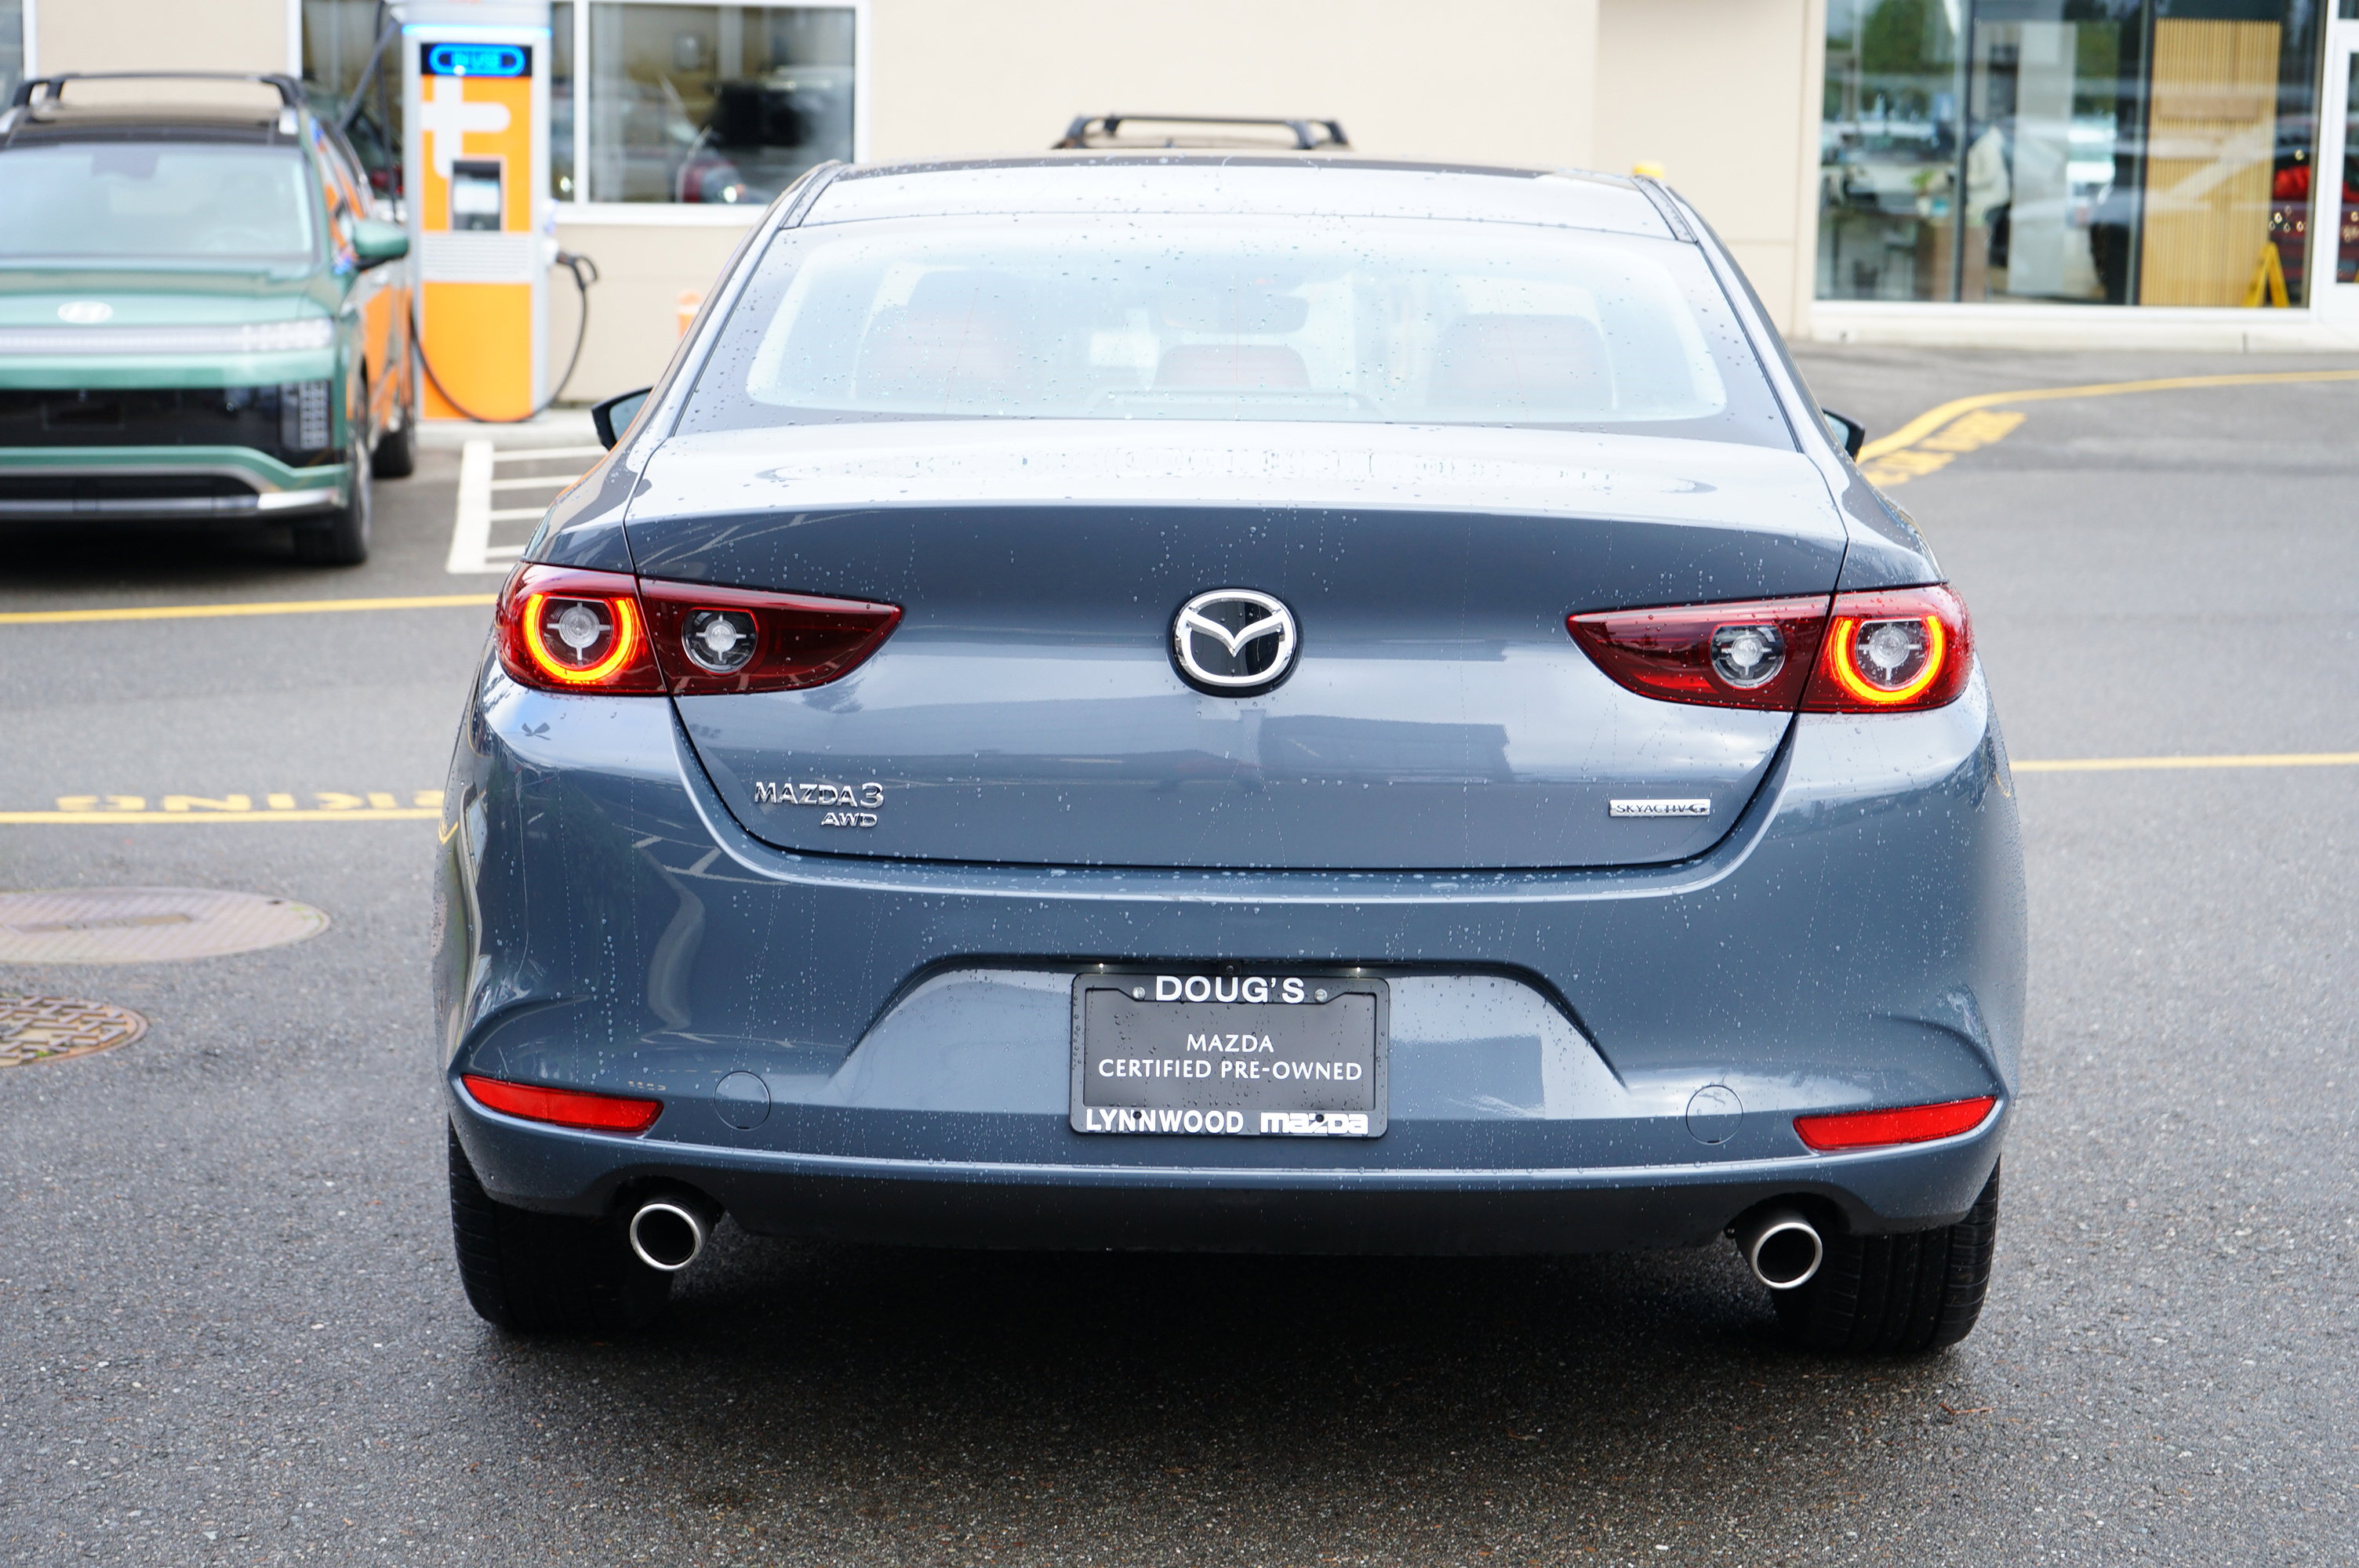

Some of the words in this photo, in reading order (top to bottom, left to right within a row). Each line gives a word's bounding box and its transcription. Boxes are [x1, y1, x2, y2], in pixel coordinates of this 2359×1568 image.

[820, 811, 878, 828] AWD
[1155, 975, 1305, 1004] DOUG'S
[1187, 1034, 1274, 1054] MAZDA
[1098, 1058, 1212, 1079] CERTIFIED
[1220, 1060, 1363, 1081] PRE-OWNED
[1085, 1108, 1245, 1134] LYNNWOOD
